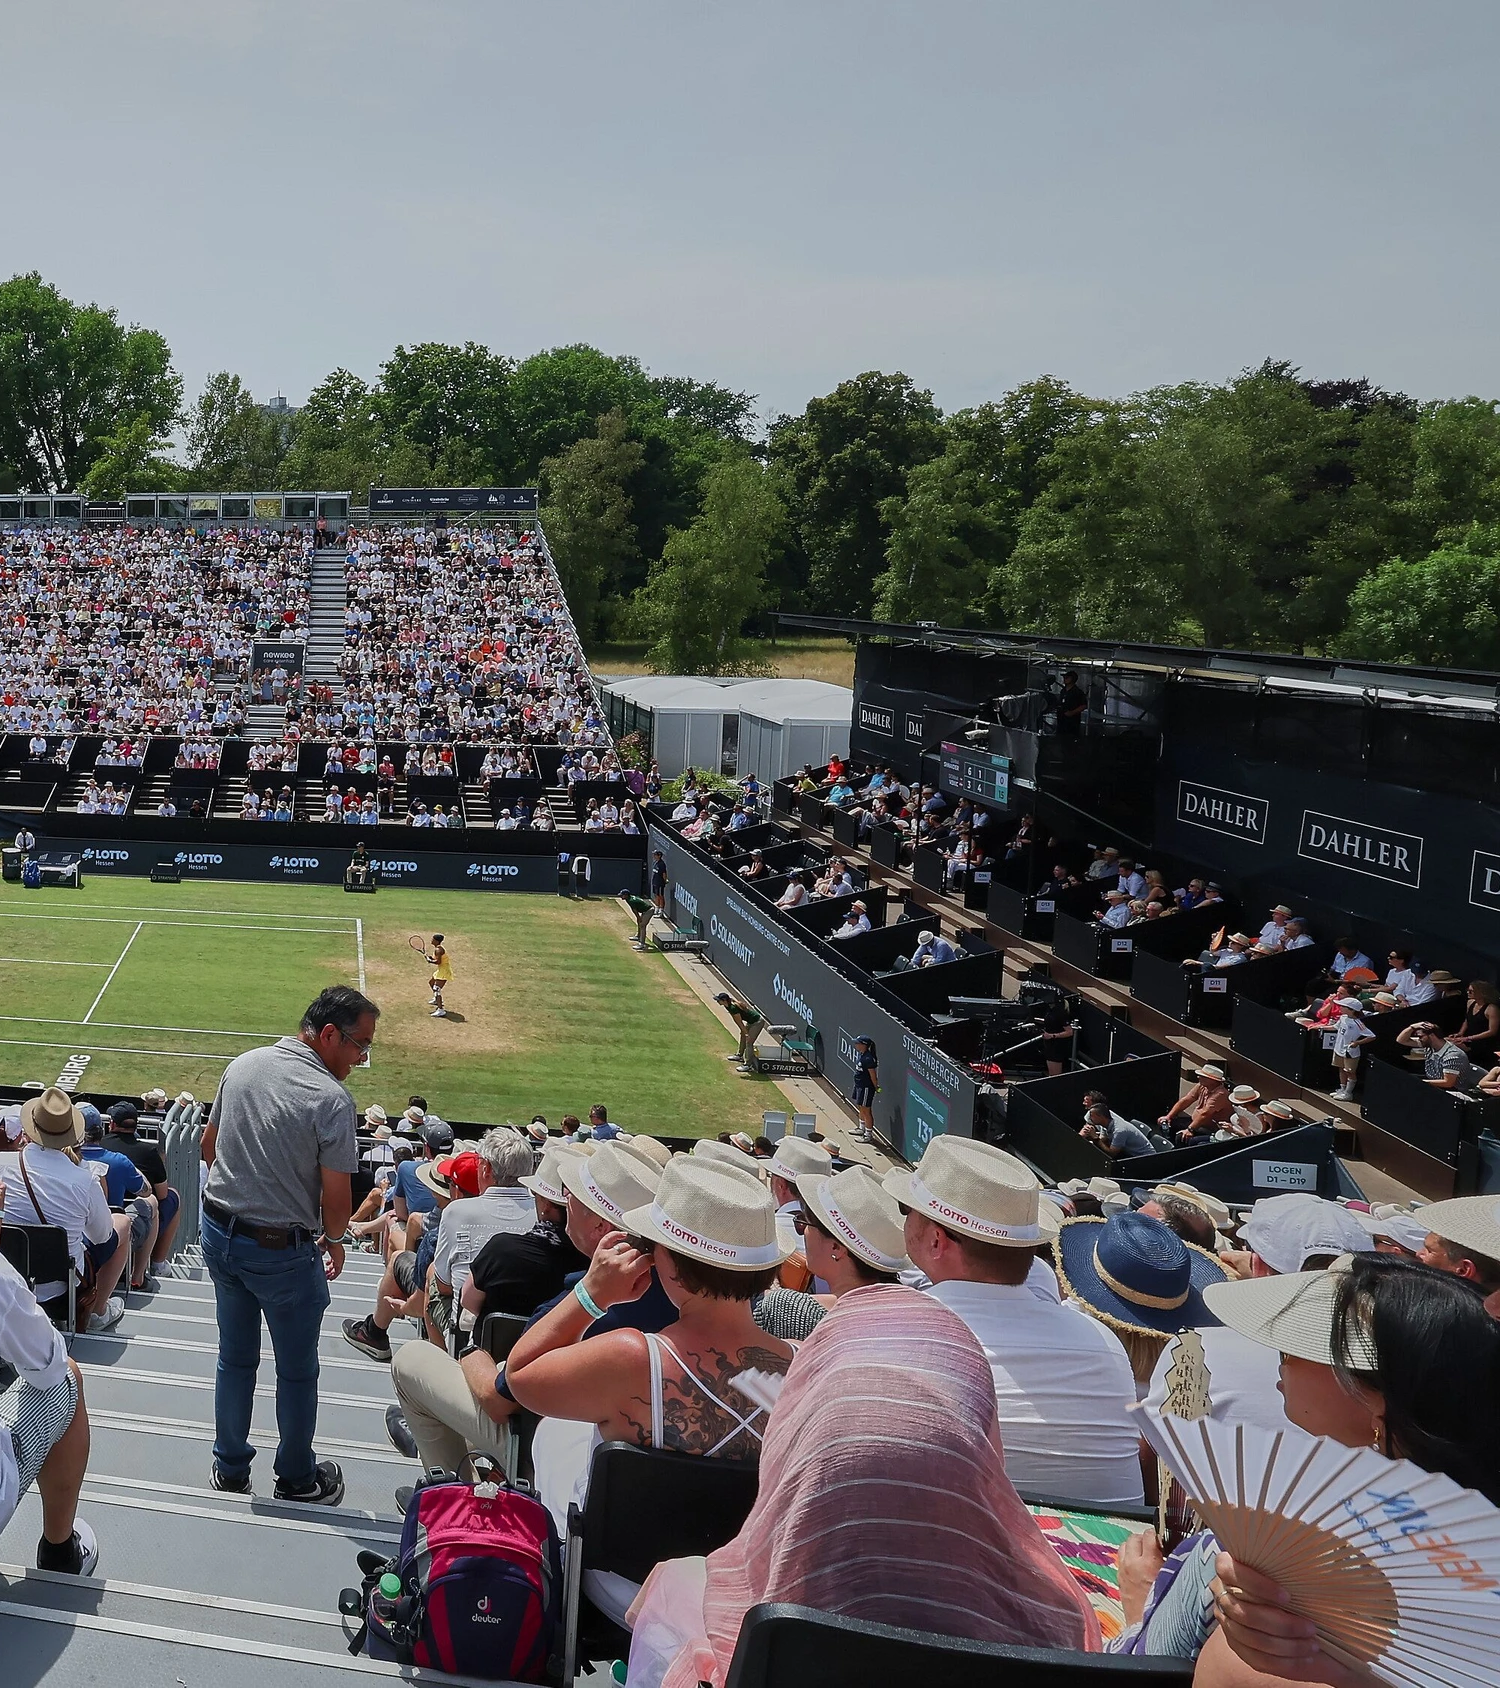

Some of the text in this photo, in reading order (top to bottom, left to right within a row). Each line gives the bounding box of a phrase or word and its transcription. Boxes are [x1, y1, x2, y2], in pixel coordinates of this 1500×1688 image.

[862, 710, 891, 729] DAHLER
[968, 767, 1004, 784] 6 1 0
[968, 780, 1004, 799] 3 4 15
[1184, 792, 1258, 831] DAHLER
[96, 850, 129, 860] LOTTO
[1308, 824, 1412, 872] DAHLER
[189, 854, 222, 864] LOTTO
[284, 857, 319, 868] LOTTO
[381, 861, 417, 872] LOTTO
[482, 865, 519, 876] LOTTO
[674, 882, 697, 916] JARLTECH
[781, 979, 813, 1026] baloise
[841, 1038, 860, 1063] DAH
[902, 1034, 960, 1091] STEIGENBERGER
[55, 1055, 91, 1092] MBURG
[908, 1058, 925, 1077] HOTELS
[930, 1076, 950, 1098] RESORTS
[917, 1117, 933, 1143] 131
[782, 1168, 795, 1177] LOTTO
[1269, 1166, 1302, 1174] LOGEN
[543, 1185, 556, 1195] LOTTO
[595, 1192, 614, 1211] LOTTO
[939, 1205, 1008, 1237] LOTTO Hessen
[671, 1225, 736, 1258] LOTTO Hessen
[836, 1218, 880, 1260] LOTTO Hessen
[472, 1613, 501, 1624] deuter
